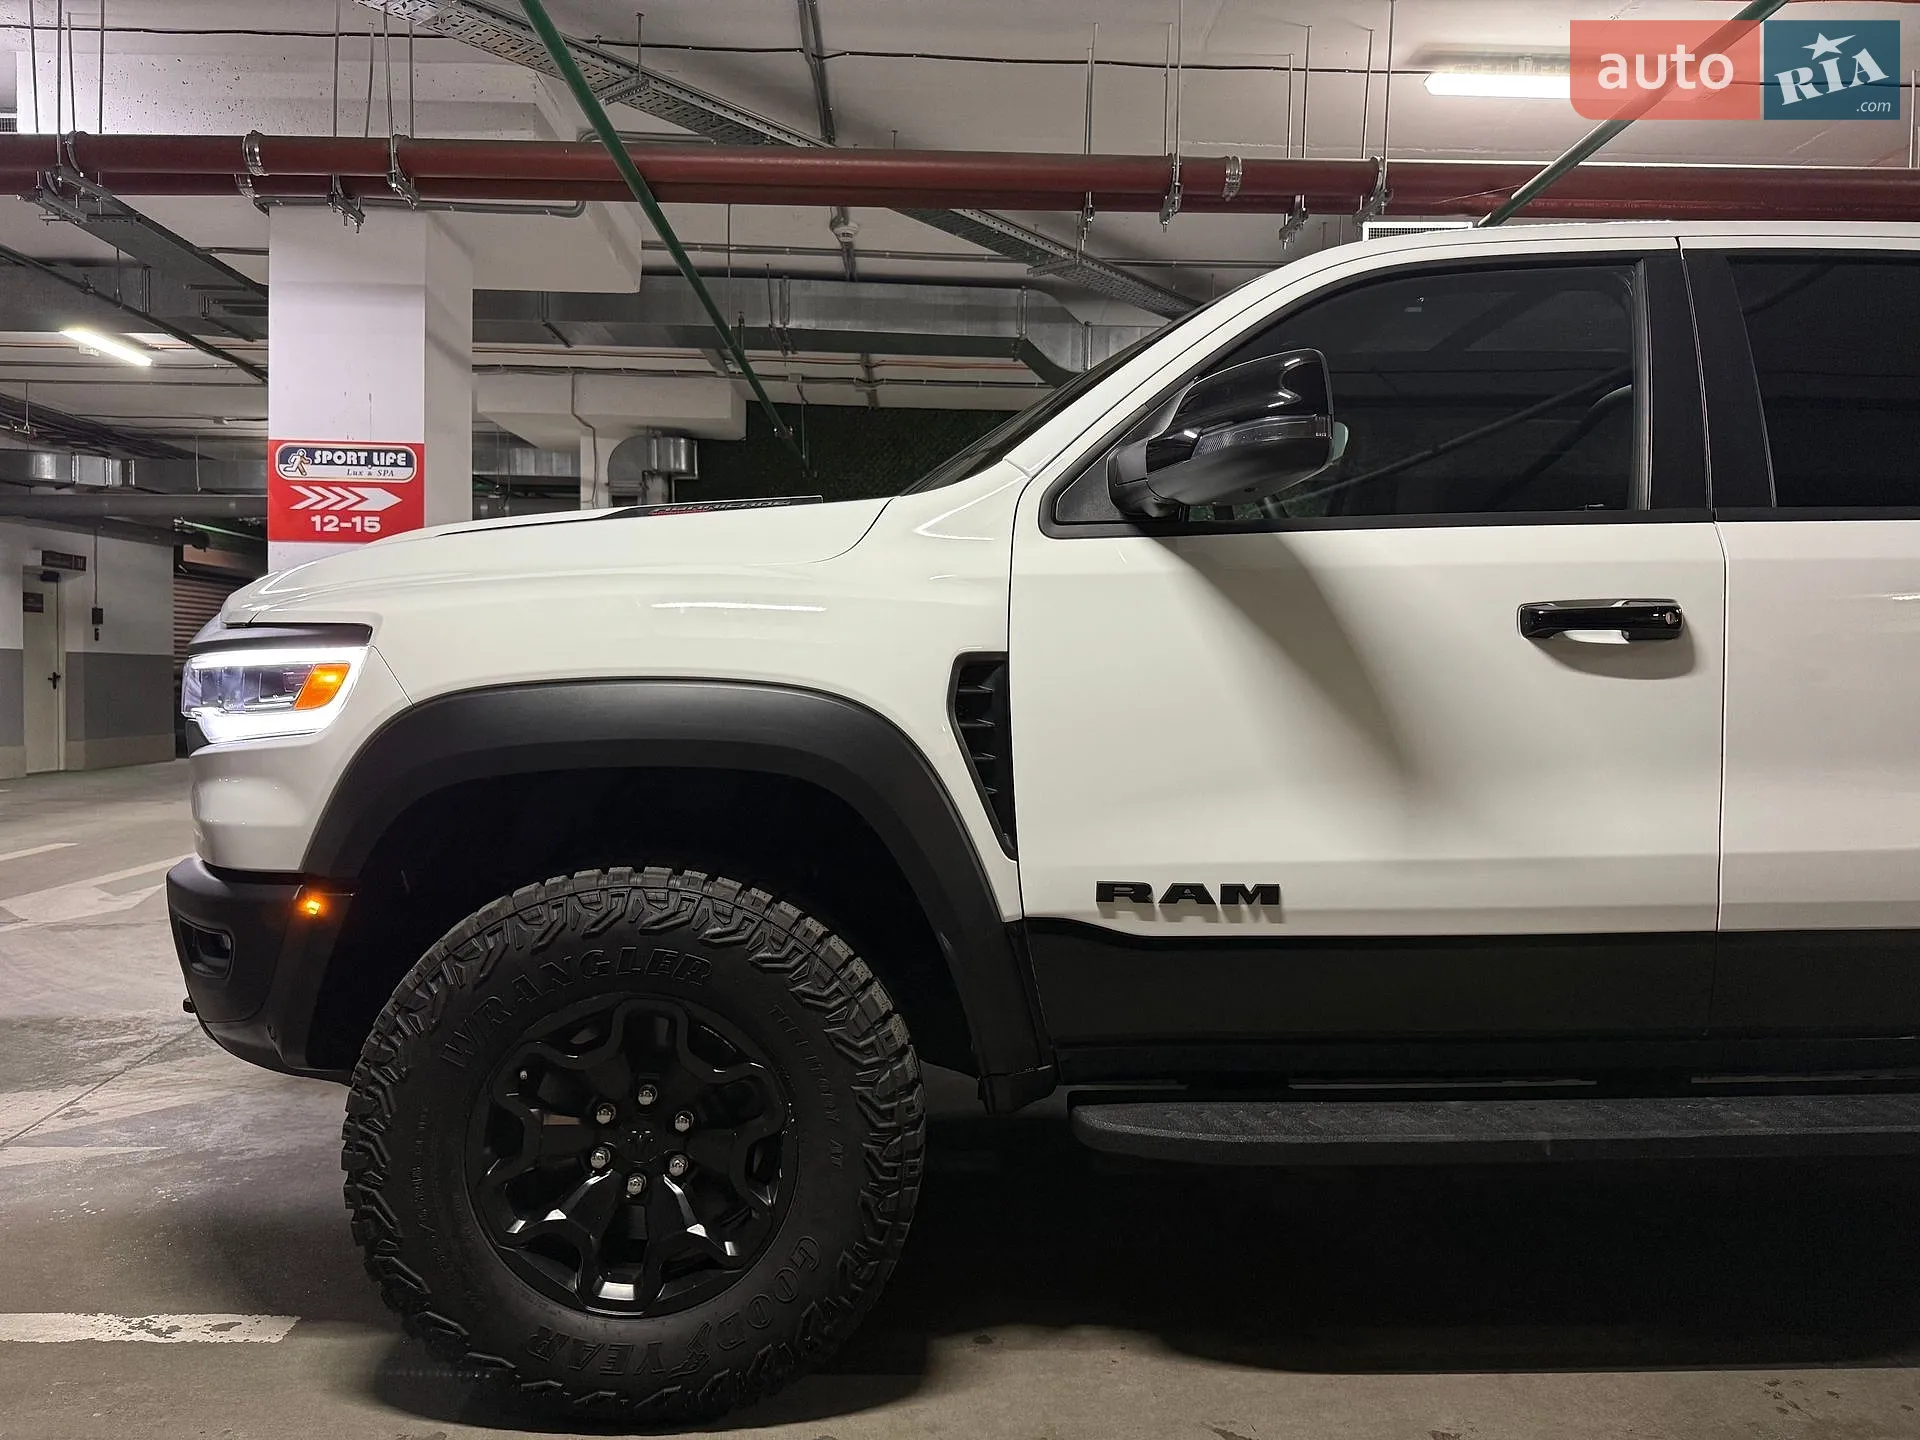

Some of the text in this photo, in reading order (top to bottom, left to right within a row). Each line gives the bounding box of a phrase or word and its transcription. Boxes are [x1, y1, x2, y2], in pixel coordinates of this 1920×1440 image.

[314, 450, 407, 466] SPORT LIFE
[377, 469, 394, 477] SPA
[311, 514, 381, 533] 12-15
[1096, 880, 1280, 906] RAM
[439, 944, 713, 1068] WRANGLER
